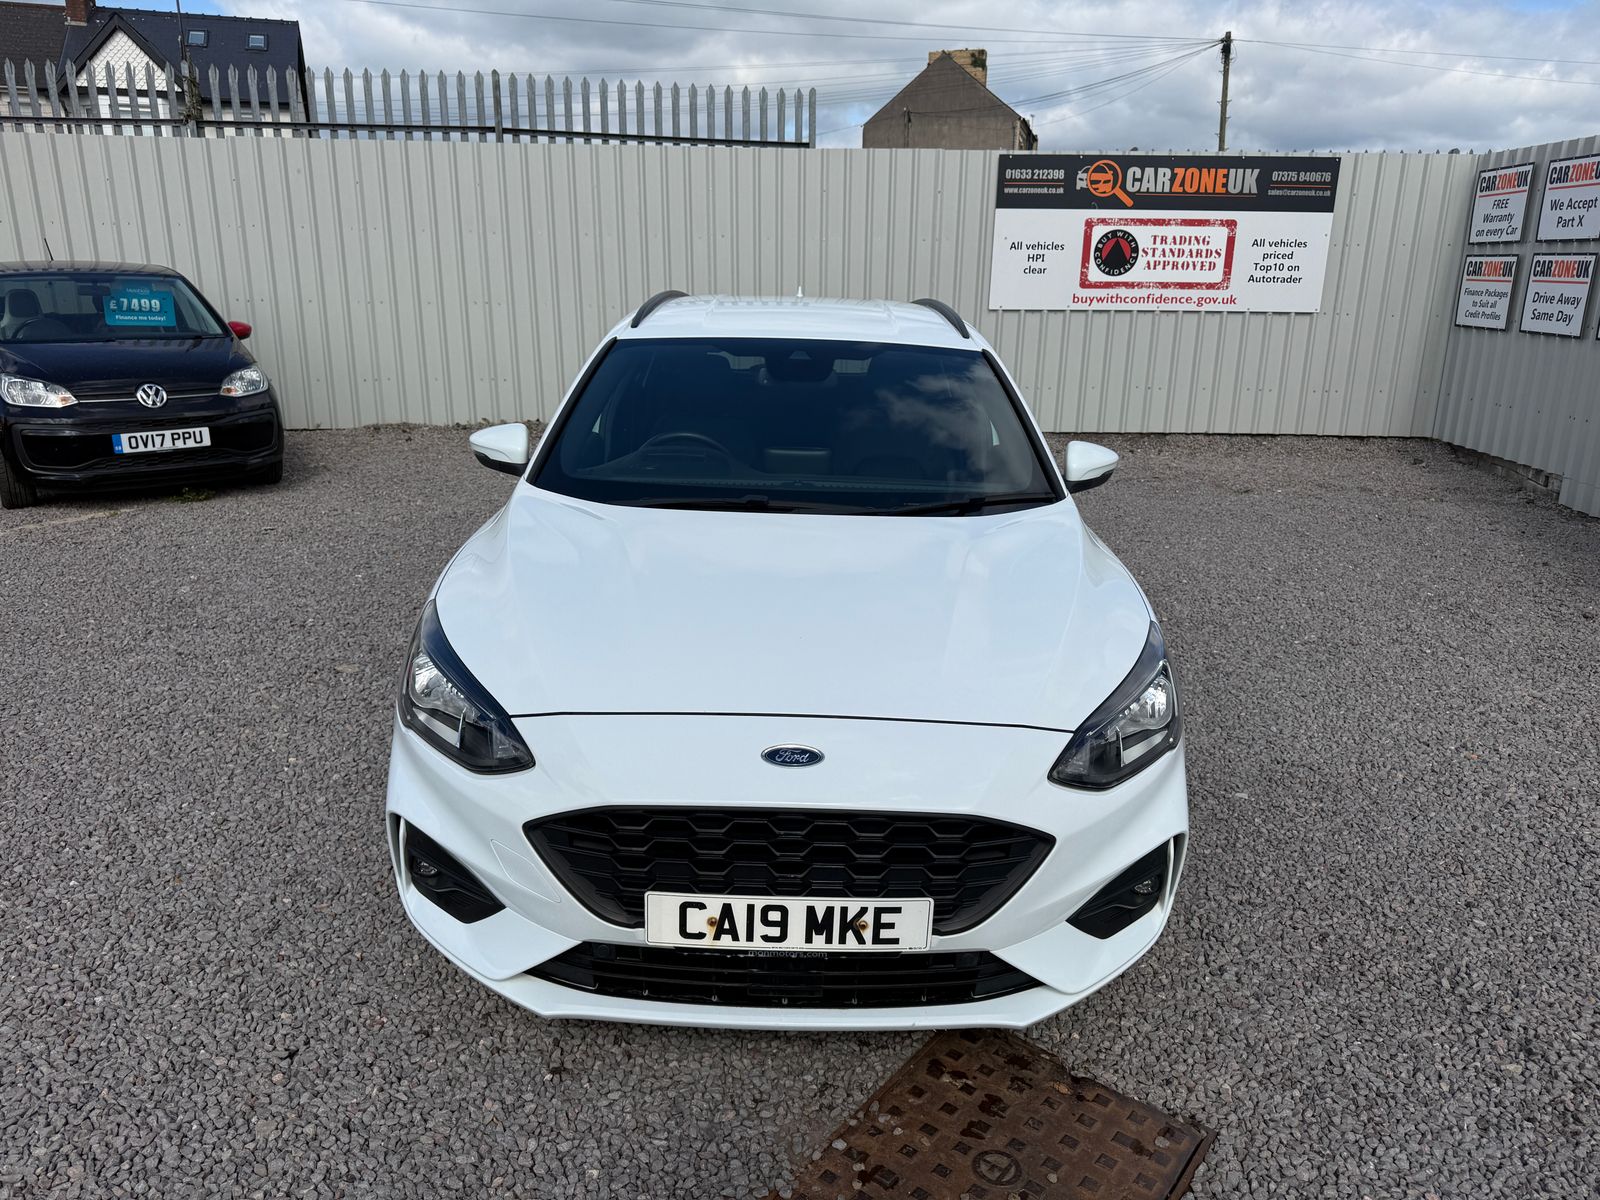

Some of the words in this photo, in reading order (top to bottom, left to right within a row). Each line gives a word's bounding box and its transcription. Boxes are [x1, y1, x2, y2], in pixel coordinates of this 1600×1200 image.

[1005, 169, 1033, 180] 01633
[1034, 169, 1065, 180] 212398
[1271, 171, 1297, 182] 07375
[1299, 172, 1332, 182] 840676
[1549, 161, 1600, 185] CARZONEU
[1126, 166, 1260, 194] CARZONEUK
[1480, 170, 1530, 193] CARZONEUK
[1004, 186, 1064, 194] www.carzoneuk.co.uk
[1268, 189, 1331, 197] sales@carzoneuk.co.uk
[1492, 199, 1510, 210] FREE
[1550, 199, 1565, 211] We
[1566, 197, 1598, 212] Accept
[1483, 212, 1515, 225] Warranty
[1556, 216, 1576, 228] Part
[1577, 215, 1585, 227] X
[1475, 229, 1485, 238] on
[1486, 227, 1505, 239] every
[1505, 225, 1518, 236] Car
[1010, 241, 1023, 251] All
[1025, 241, 1065, 251] vehicles
[1097, 232, 1113, 249] BUY
[1116, 231, 1136, 249] WITH
[1151, 235, 1211, 246] TRADING
[1251, 238, 1266, 248] All
[1268, 238, 1308, 248] vehicles
[1027, 253, 1045, 263] HPI
[1141, 247, 1222, 259] STANDARDS
[1262, 250, 1294, 261] priced
[1023, 265, 1048, 275] clear
[1094, 252, 1138, 275] CONFIDENCE
[1143, 260, 1217, 271] APPROVED
[1253, 262, 1285, 273] Top10
[1286, 264, 1300, 272] on
[1466, 261, 1515, 278] CARZONEUK
[1533, 260, 1592, 278] CARZONEUK
[1247, 274, 1303, 284] Autotrader
[1072, 293, 1237, 307] buywithconfidence.gov.uk
[1464, 287, 1484, 297] Finance
[1484, 289, 1509, 300] Packages
[1472, 300, 1478, 308] to
[1478, 300, 1489, 308] Suit
[1532, 291, 1556, 304] Drive
[1556, 292, 1583, 310] Away
[1464, 310, 1480, 319] Credit
[1481, 311, 1501, 321] Profiles
[1530, 308, 1554, 321] Same
[1555, 310, 1574, 327] Day
[127, 433, 165, 450] OV17
[170, 430, 204, 447] PPU
[775, 749, 810, 763] Ford
[679, 901, 789, 943] CA19
[805, 905, 902, 945] MKE
